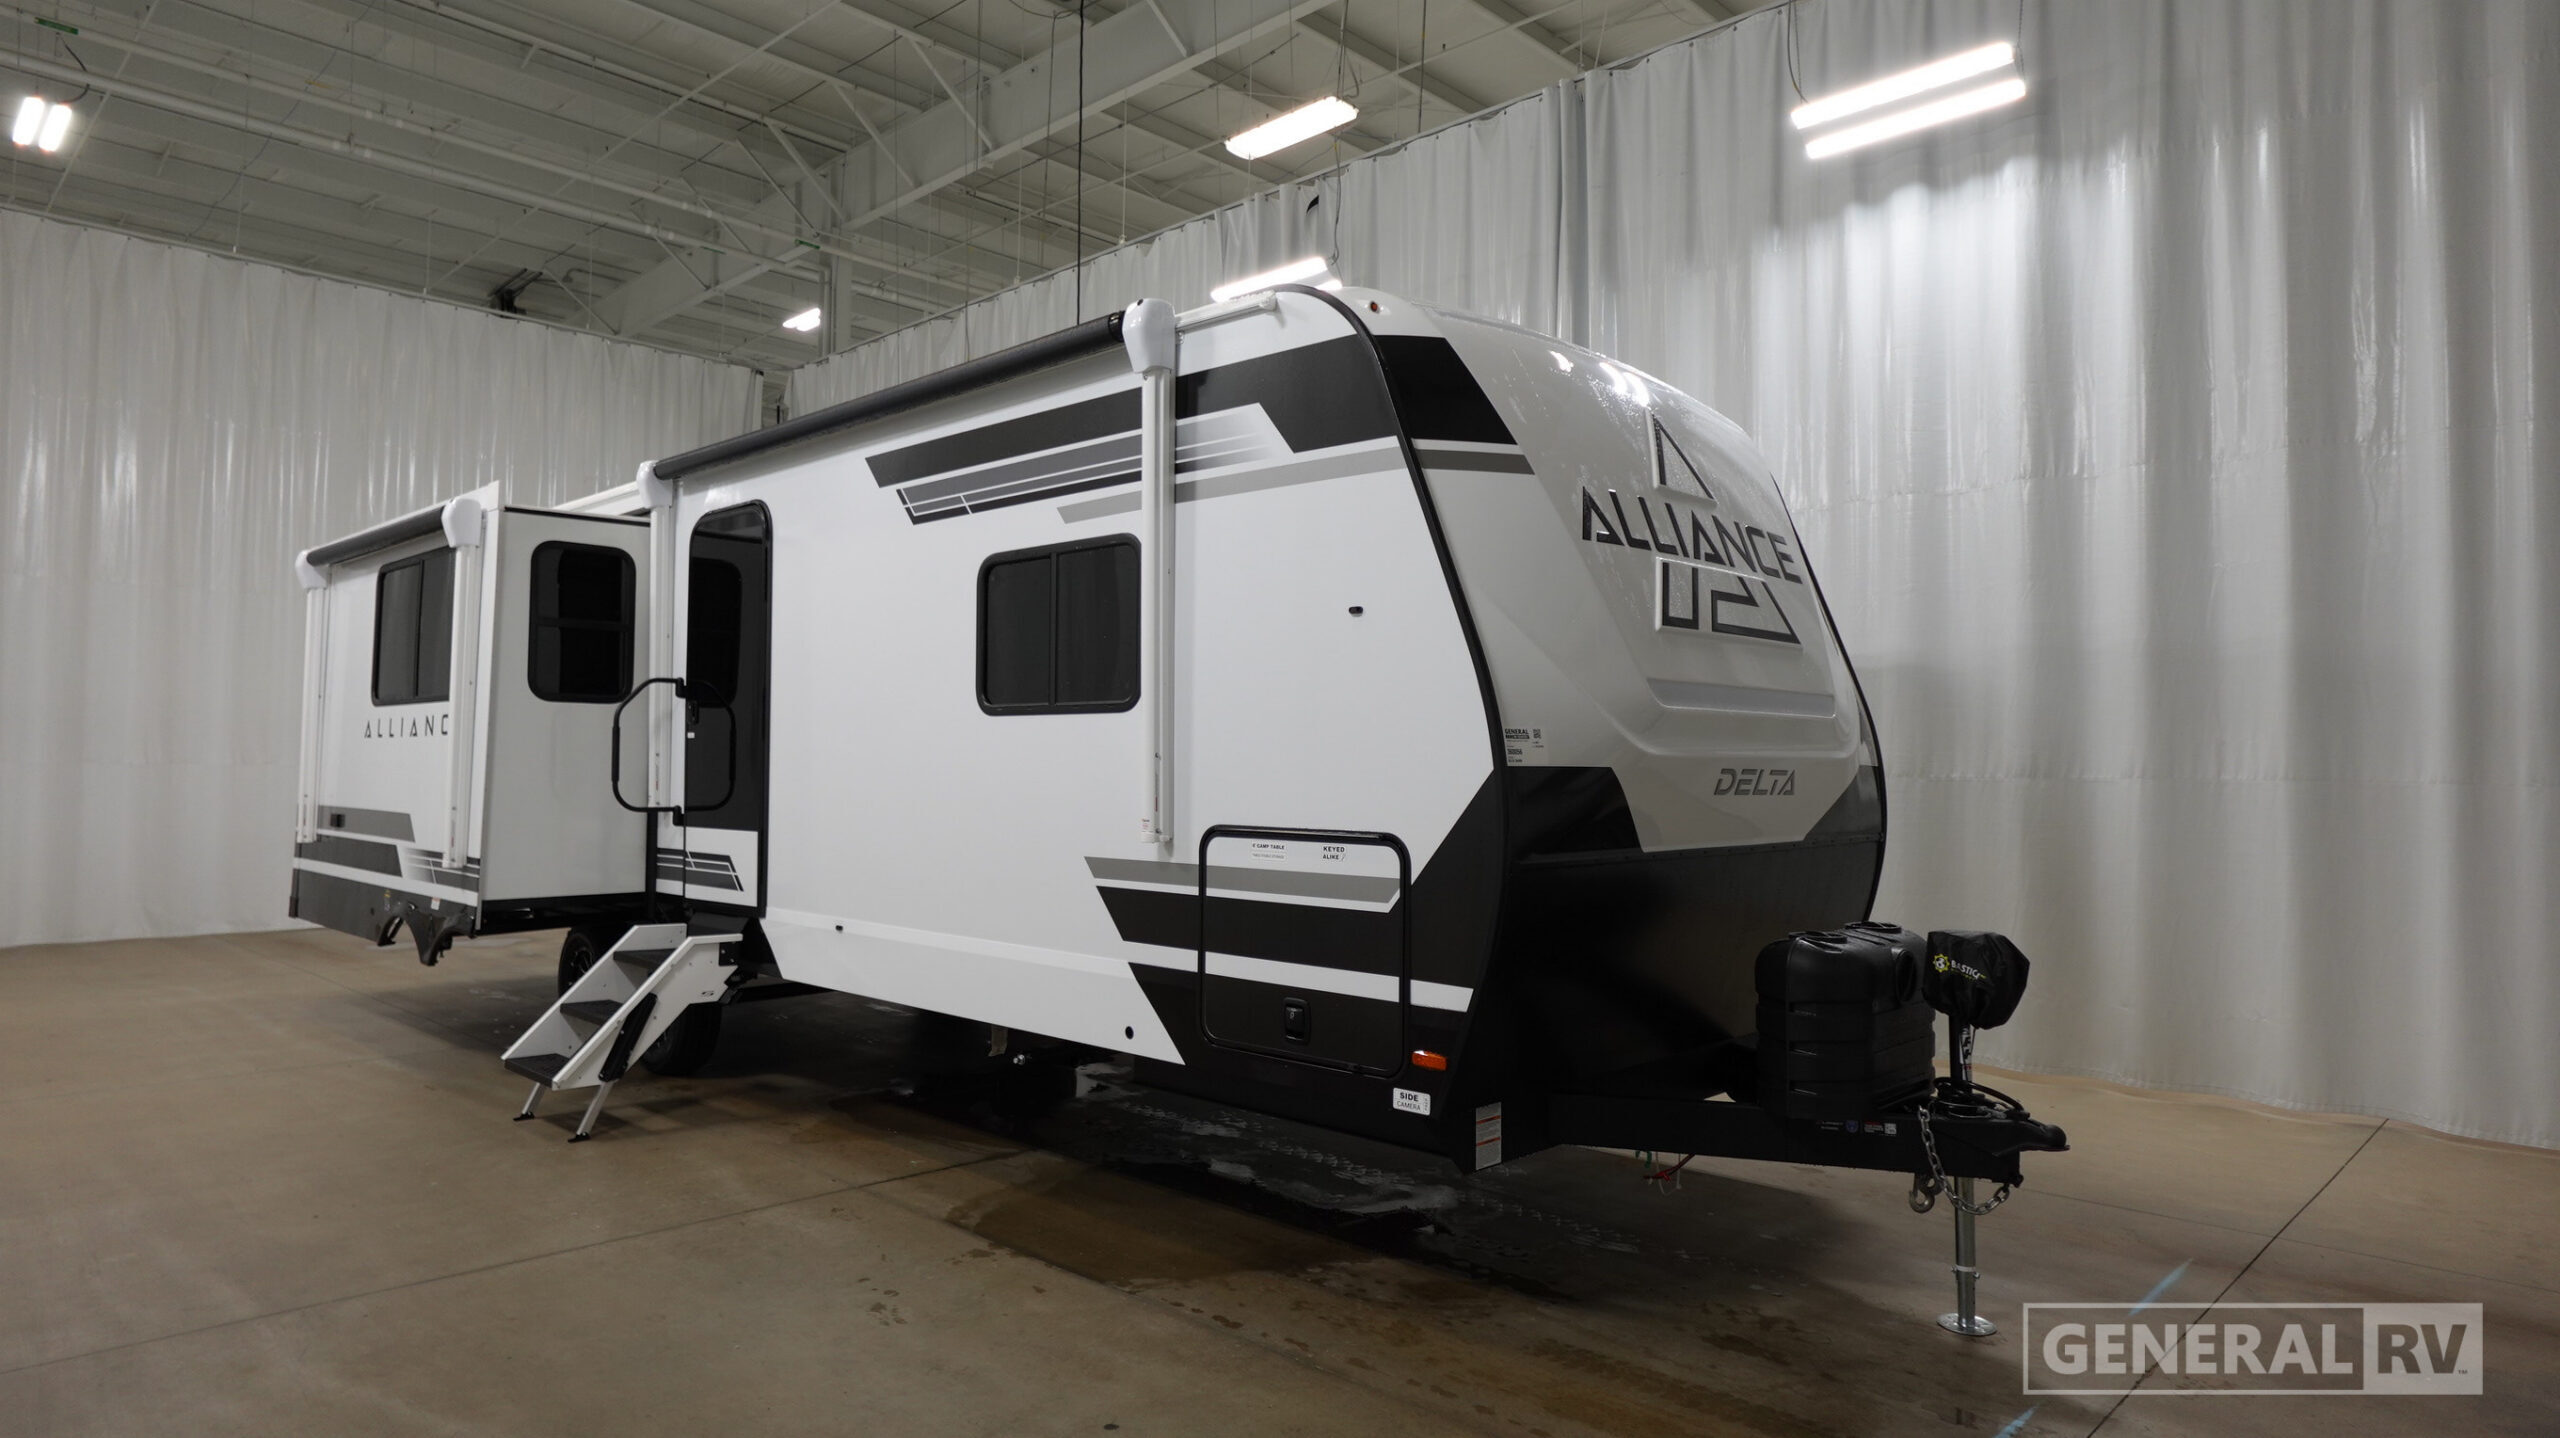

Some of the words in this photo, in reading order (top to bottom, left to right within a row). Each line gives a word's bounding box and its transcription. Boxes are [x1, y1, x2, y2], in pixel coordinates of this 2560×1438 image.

[1581, 485, 1803, 585] ALLIANCE
[364, 713, 449, 739] ALLIANC
[1713, 768, 1796, 796] DELTA
[1396, 1100, 1421, 1111] CAMERA
[1399, 1092, 1419, 1102] SIDE
